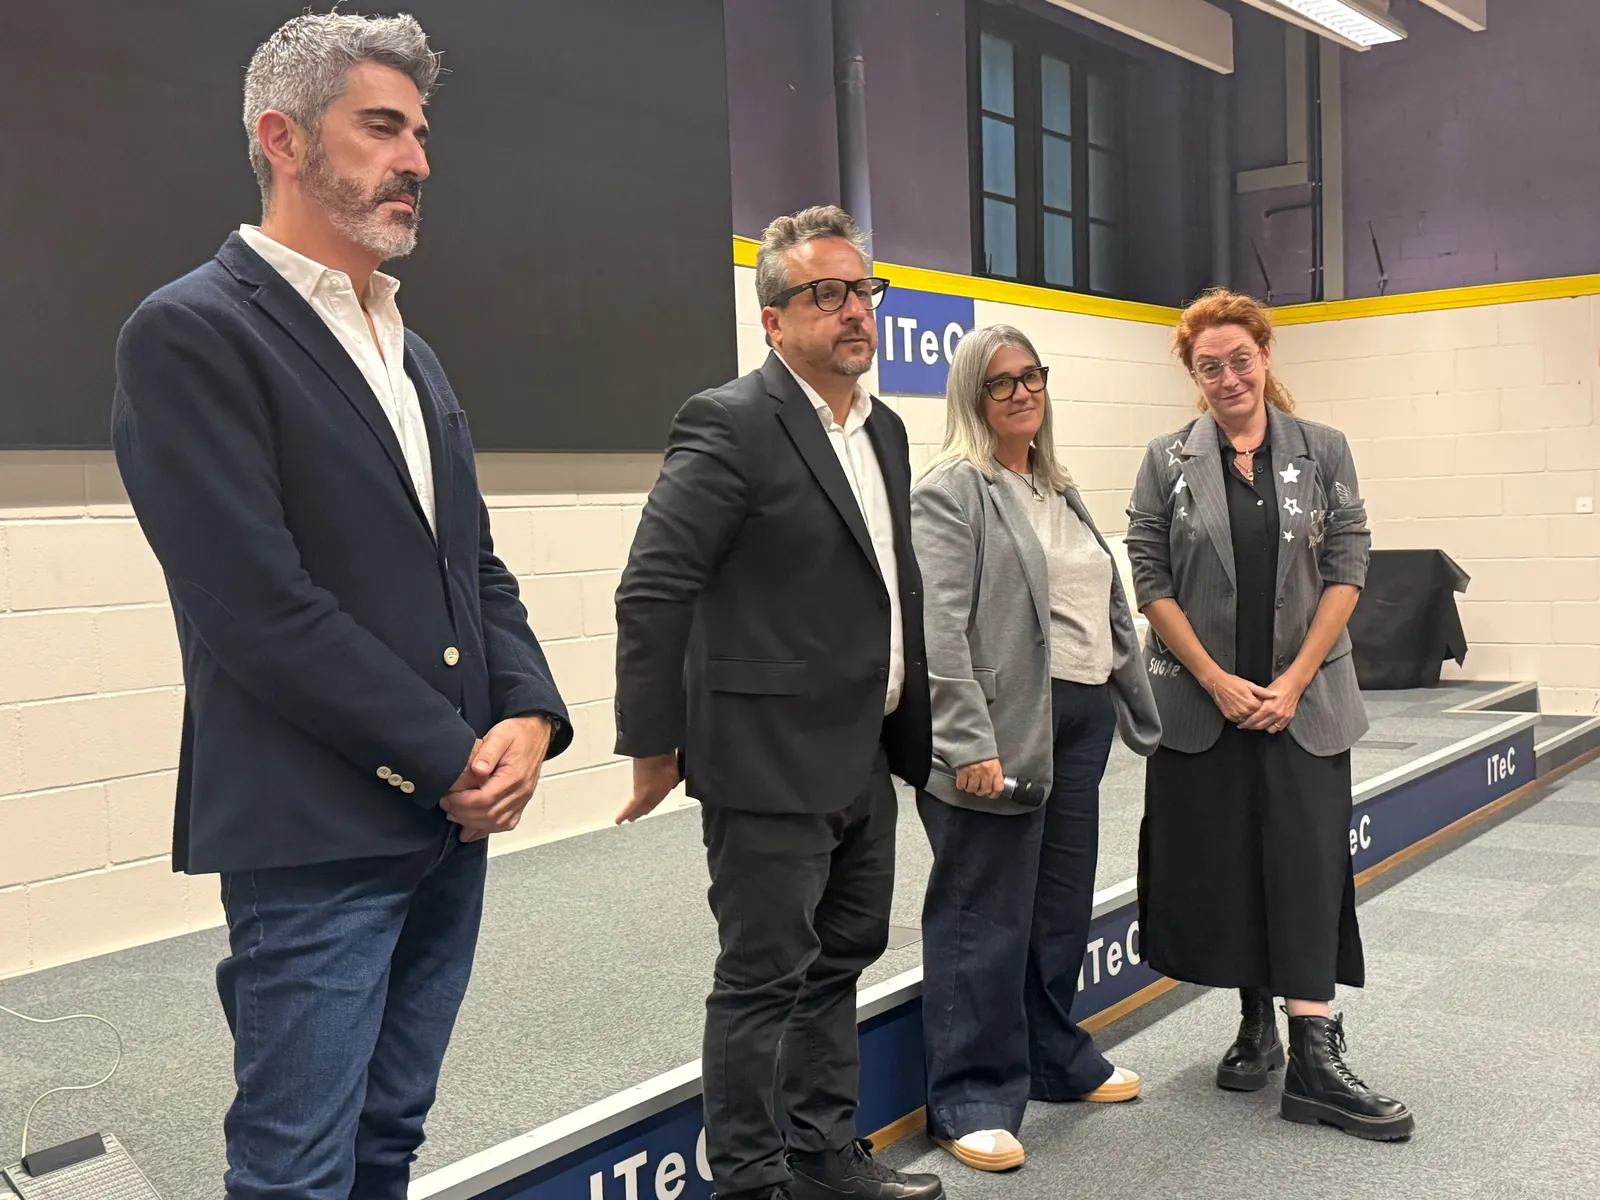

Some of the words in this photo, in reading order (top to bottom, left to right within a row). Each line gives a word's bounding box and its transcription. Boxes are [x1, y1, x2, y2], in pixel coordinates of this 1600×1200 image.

[884, 316, 964, 365] ITeC
[1487, 746, 1516, 786] ITeC
[1349, 814, 1371, 856] eC
